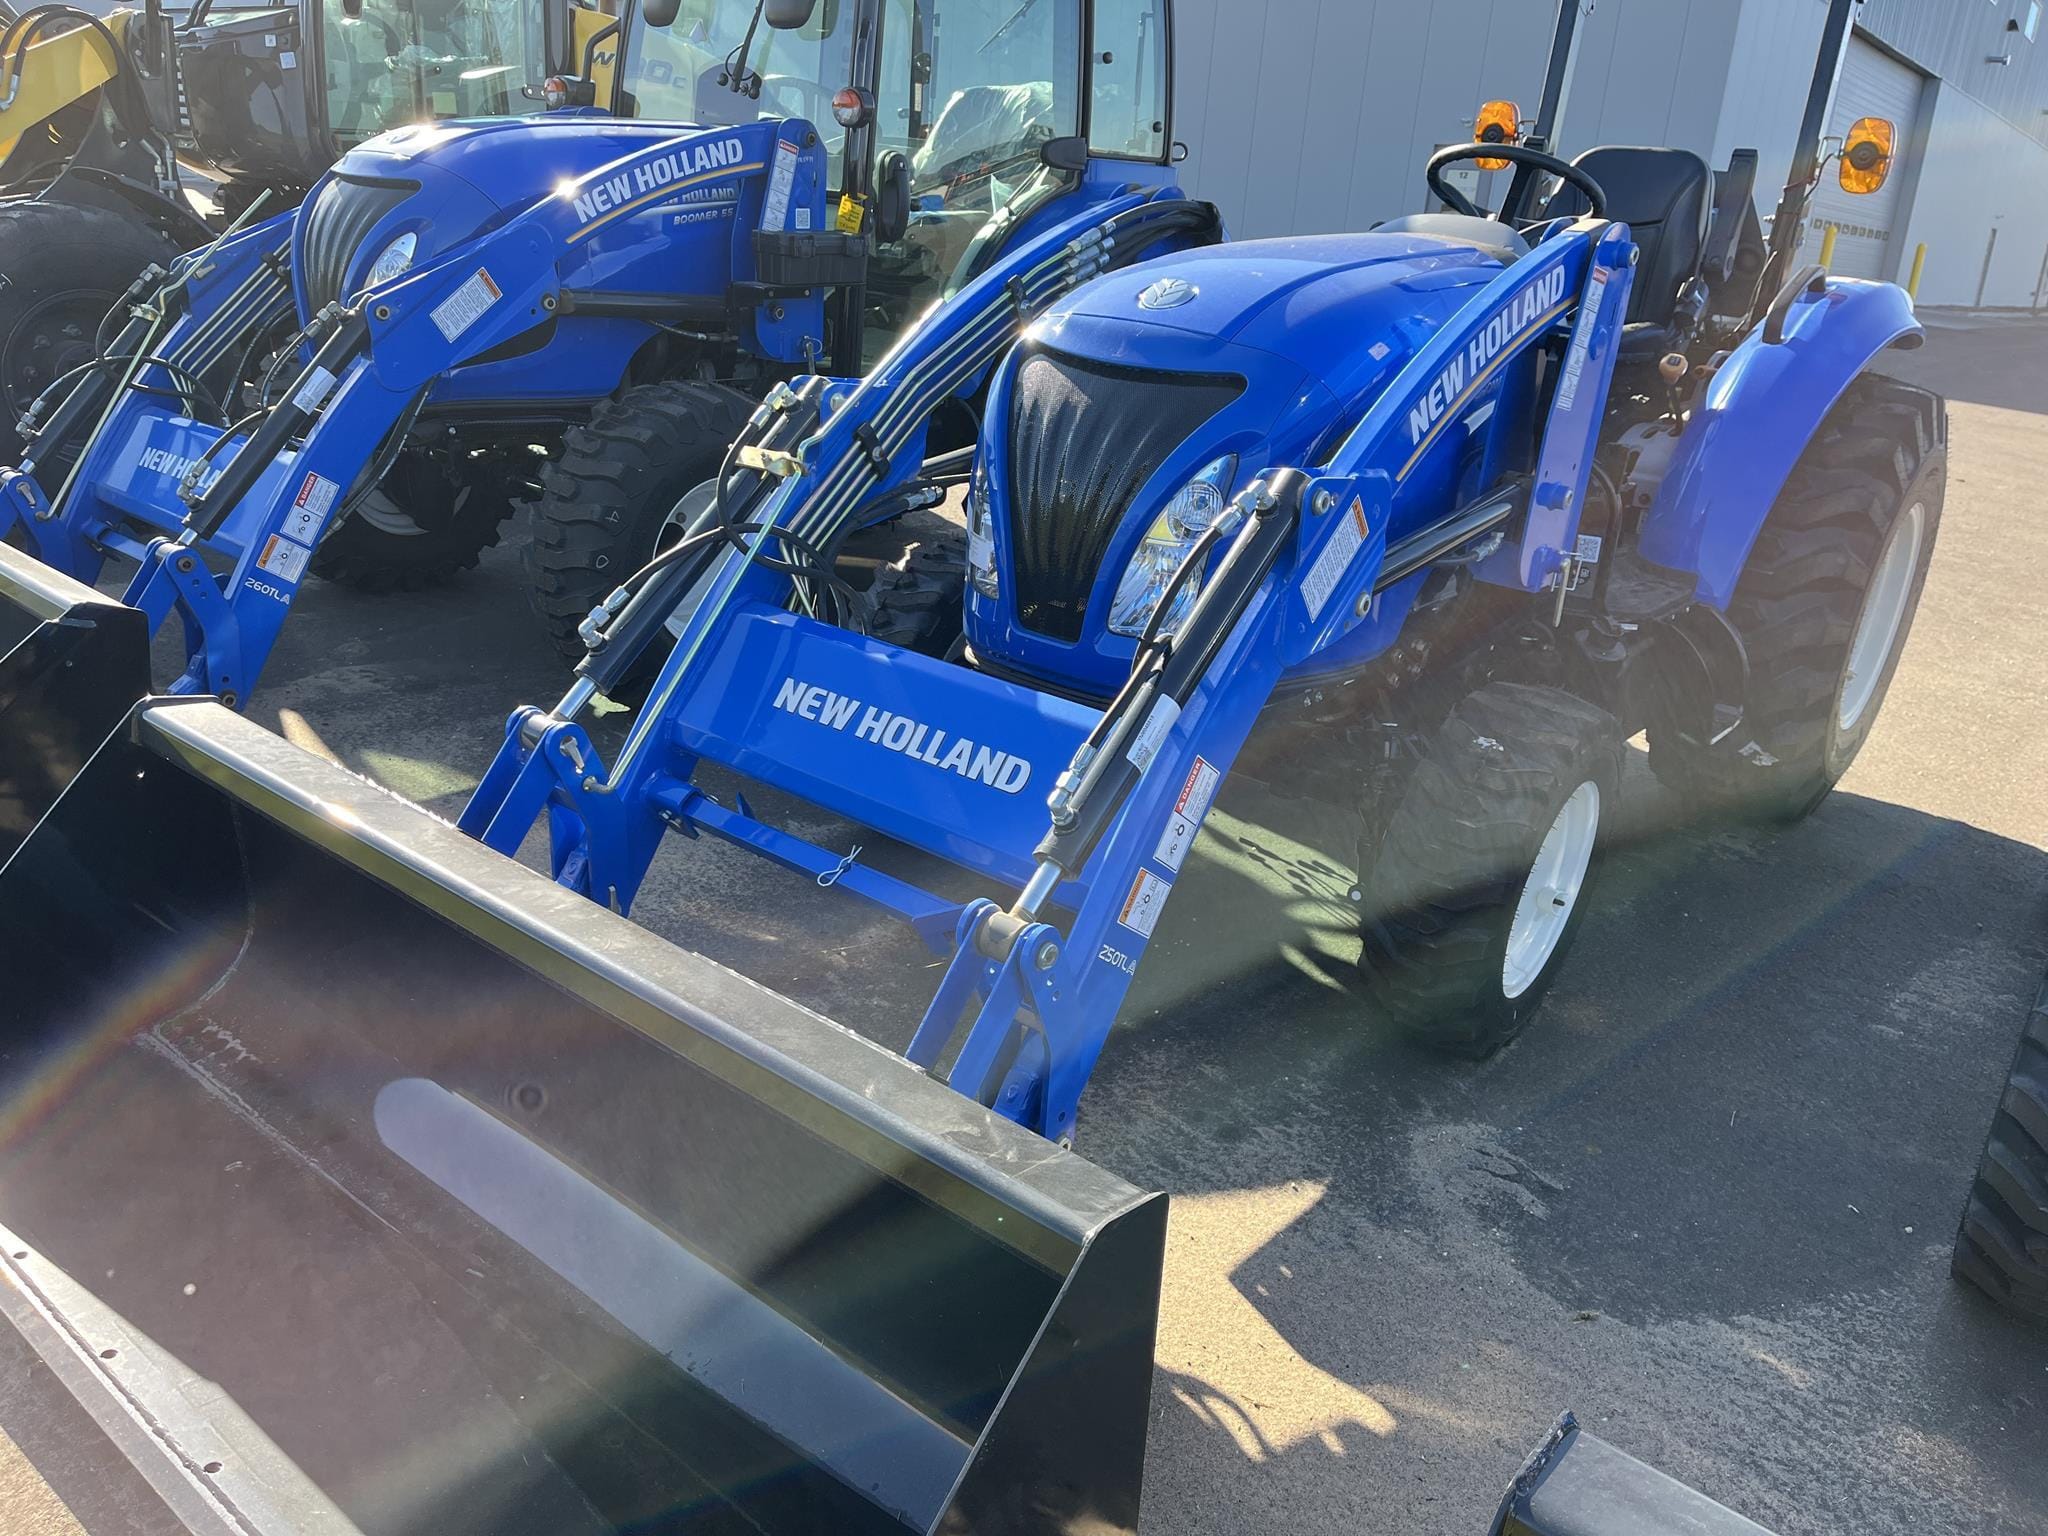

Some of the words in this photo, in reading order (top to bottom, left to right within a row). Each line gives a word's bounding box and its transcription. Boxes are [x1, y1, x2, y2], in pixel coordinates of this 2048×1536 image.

[572, 173, 633, 224] NEW
[634, 138, 744, 193] HOLLAND
[673, 211, 718, 225] BOOMER
[1409, 352, 1464, 446] NEW
[1469, 264, 1566, 378] HOLLAND
[139, 446, 177, 475] NEW
[244, 577, 291, 605] 260TLA
[773, 677, 861, 731] NEW
[854, 706, 1031, 794] HOLLAND
[1182, 762, 1201, 800] DANGER
[1098, 944, 1137, 976] 250TLA
